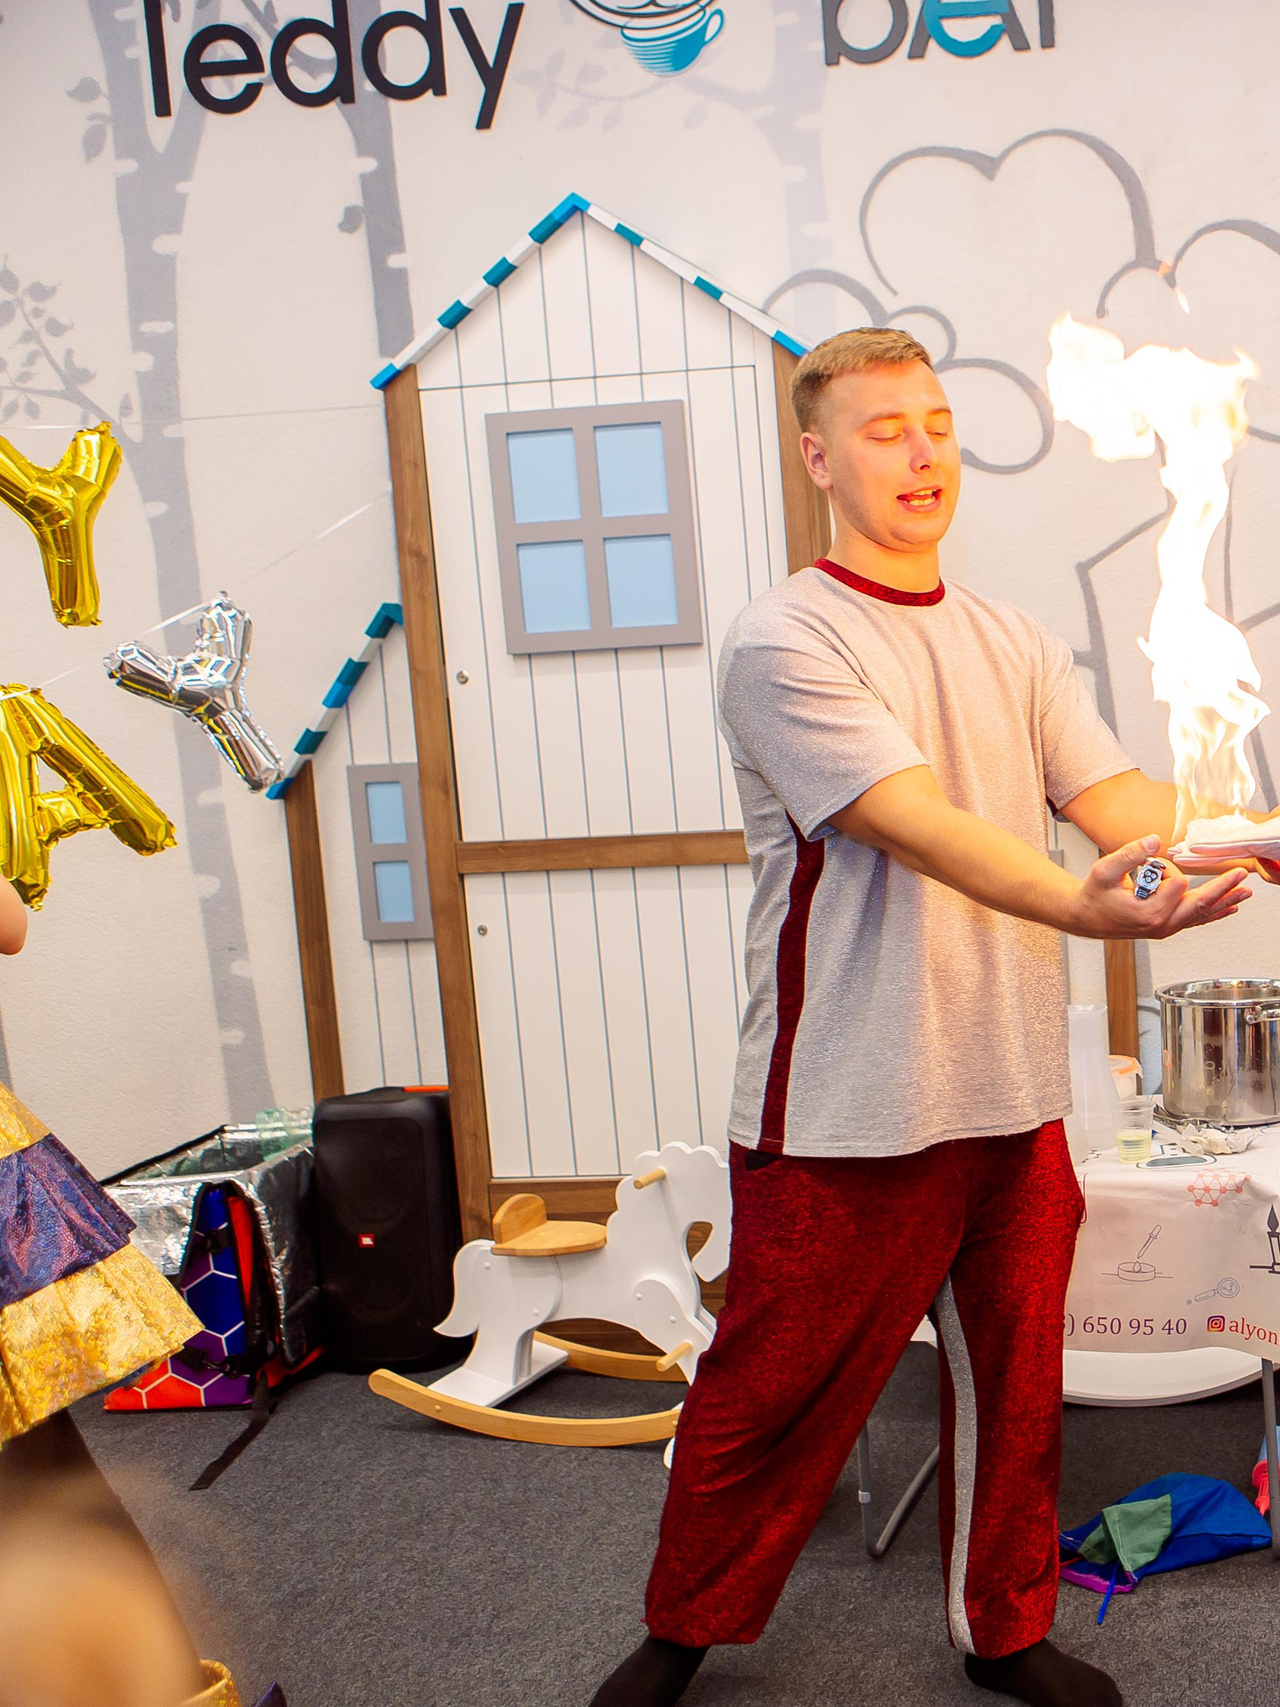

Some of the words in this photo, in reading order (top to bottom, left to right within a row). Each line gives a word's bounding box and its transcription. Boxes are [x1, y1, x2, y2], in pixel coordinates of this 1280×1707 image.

[1083, 1316, 1122, 1336] 650
[1129, 1318, 1154, 1336] 95
[1161, 1318, 1188, 1336] 40
